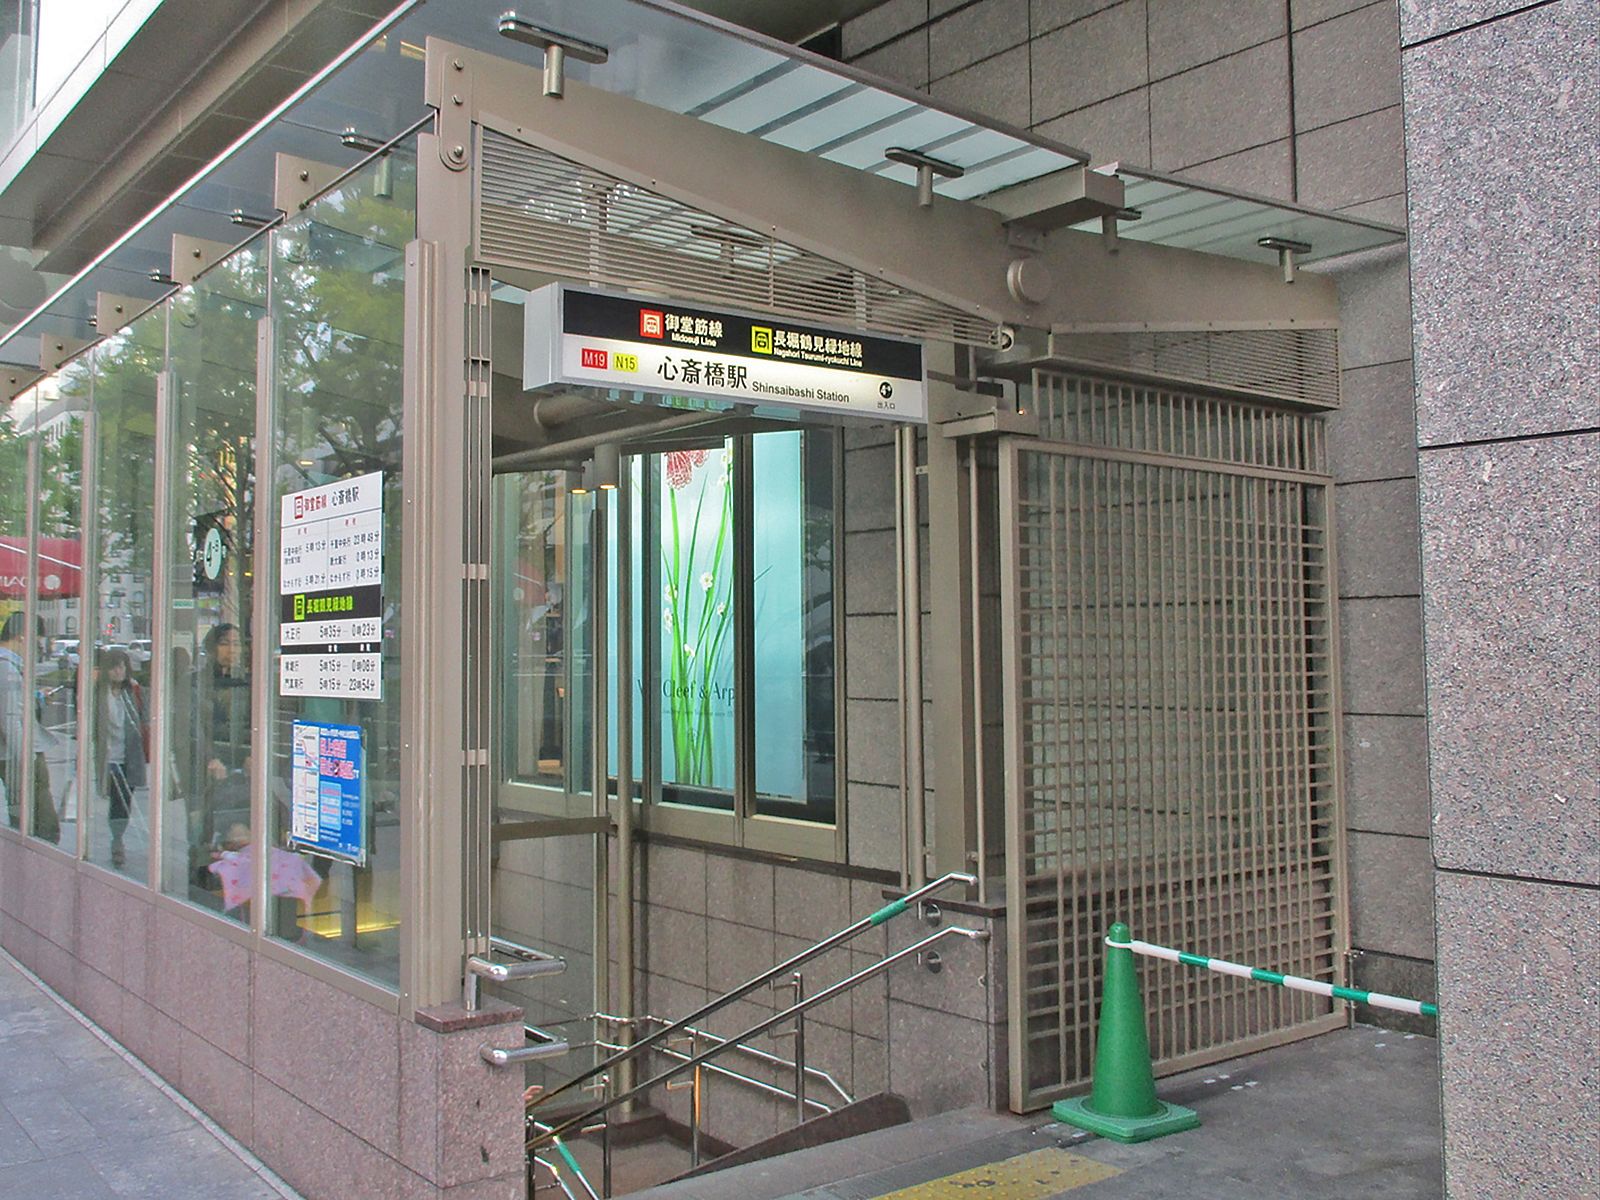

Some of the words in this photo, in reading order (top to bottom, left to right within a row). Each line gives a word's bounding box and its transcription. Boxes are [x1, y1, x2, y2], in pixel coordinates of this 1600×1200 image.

[665, 313, 723, 338] 御堂筋線
[671, 332, 700, 346] Midosuji
[700, 336, 717, 347] Line
[774, 330, 863, 358] 長堀鶴見緑地線
[584, 351, 606, 367] M19
[615, 355, 636, 370] N15
[774, 347, 801, 359] Nagahori
[850, 358, 863, 367] Line
[657, 355, 748, 389] 心斎橋駅
[752, 380, 815, 399] Shinsaibashi
[816, 389, 850, 403] Station
